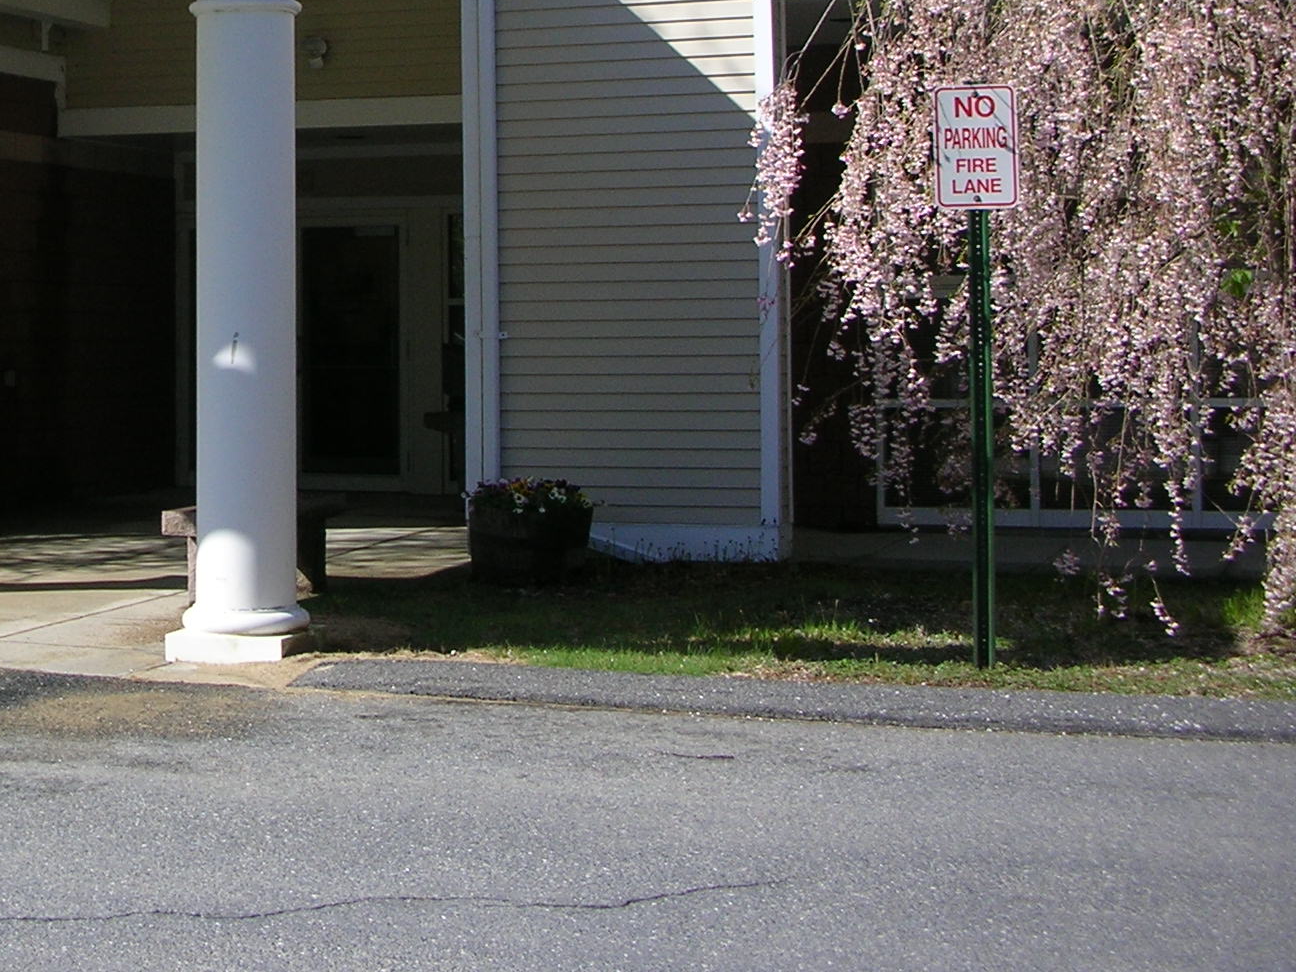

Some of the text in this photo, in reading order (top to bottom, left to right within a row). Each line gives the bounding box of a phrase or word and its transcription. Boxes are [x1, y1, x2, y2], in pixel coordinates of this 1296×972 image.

[954, 95, 995, 118] NO
[944, 126, 1007, 149] PARKING
[956, 158, 997, 173] FIRE
[952, 178, 1002, 194] LANE
